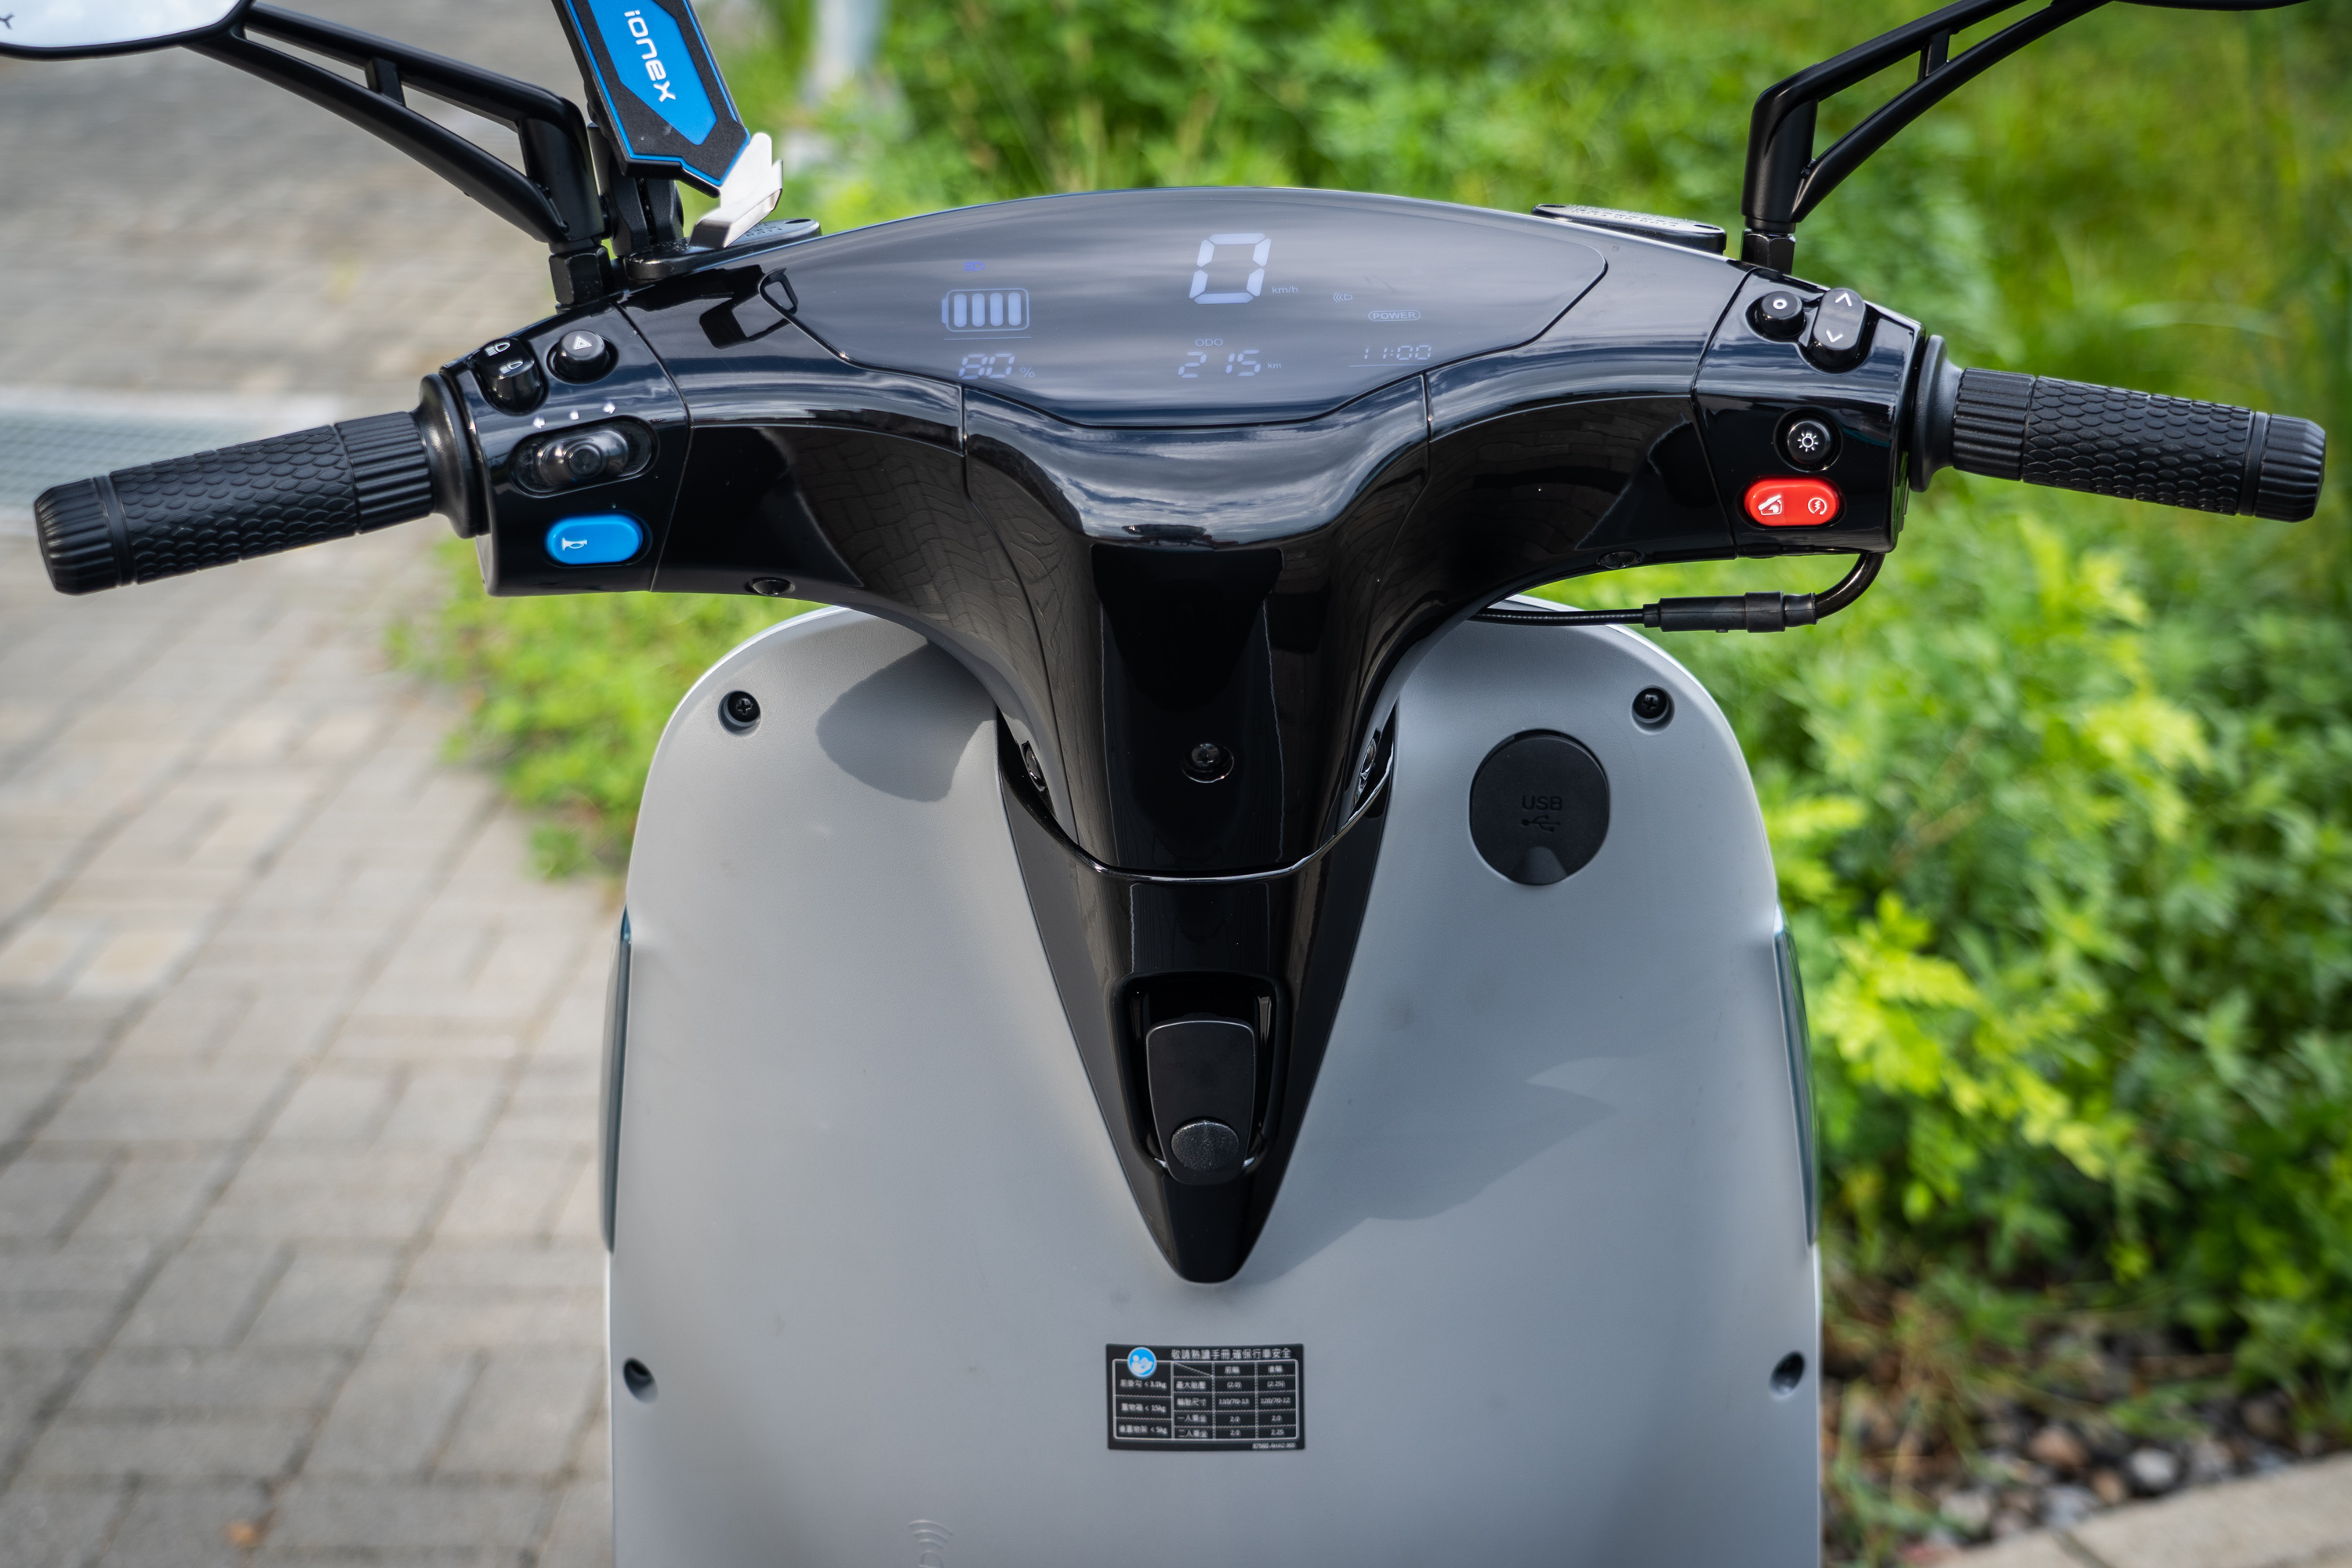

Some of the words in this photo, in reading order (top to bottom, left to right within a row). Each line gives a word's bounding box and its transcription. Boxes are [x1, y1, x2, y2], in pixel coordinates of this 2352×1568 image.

[624, 9, 676, 103] ionex
[1189, 233, 1272, 305] 0
[1272, 285, 1299, 294] km/h
[1372, 311, 1417, 320] POWER
[1364, 344, 1432, 361] 11:00
[1522, 795, 1563, 811] USB
